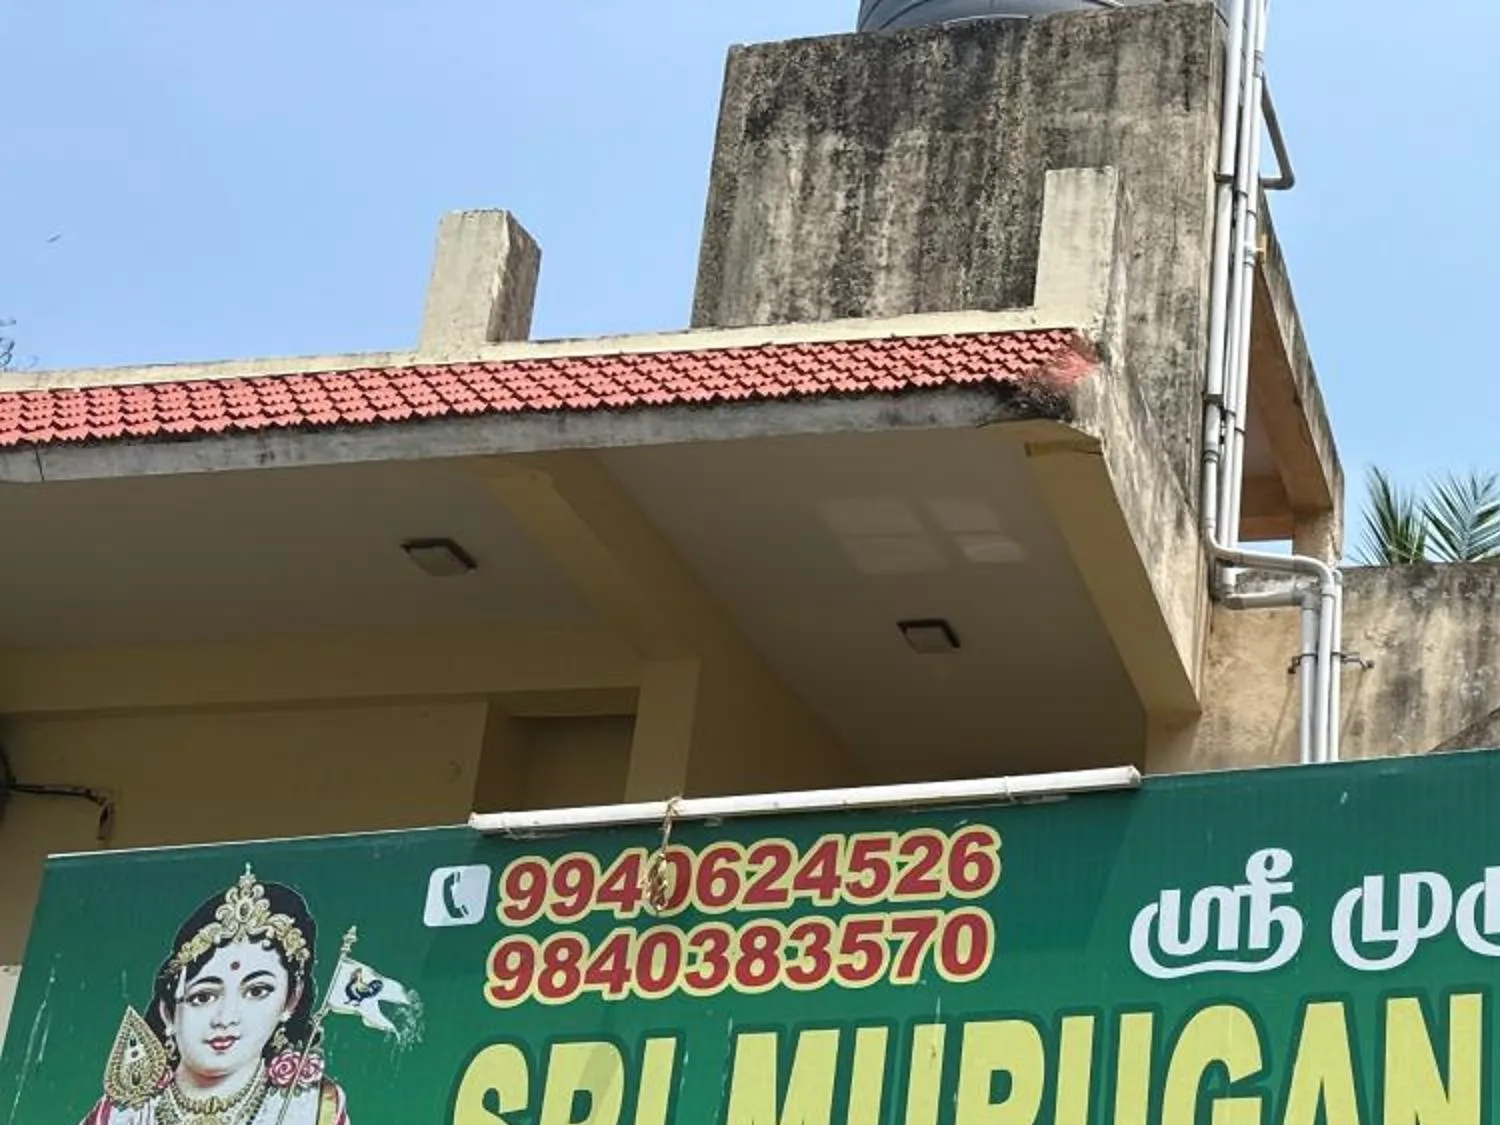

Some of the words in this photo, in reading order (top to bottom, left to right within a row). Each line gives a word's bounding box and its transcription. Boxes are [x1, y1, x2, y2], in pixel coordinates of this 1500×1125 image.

[495, 827, 1004, 927] 9940624526
[1129, 847, 1303, 979] ஸ்ரீ
[484, 907, 998, 1009] 9840383570
